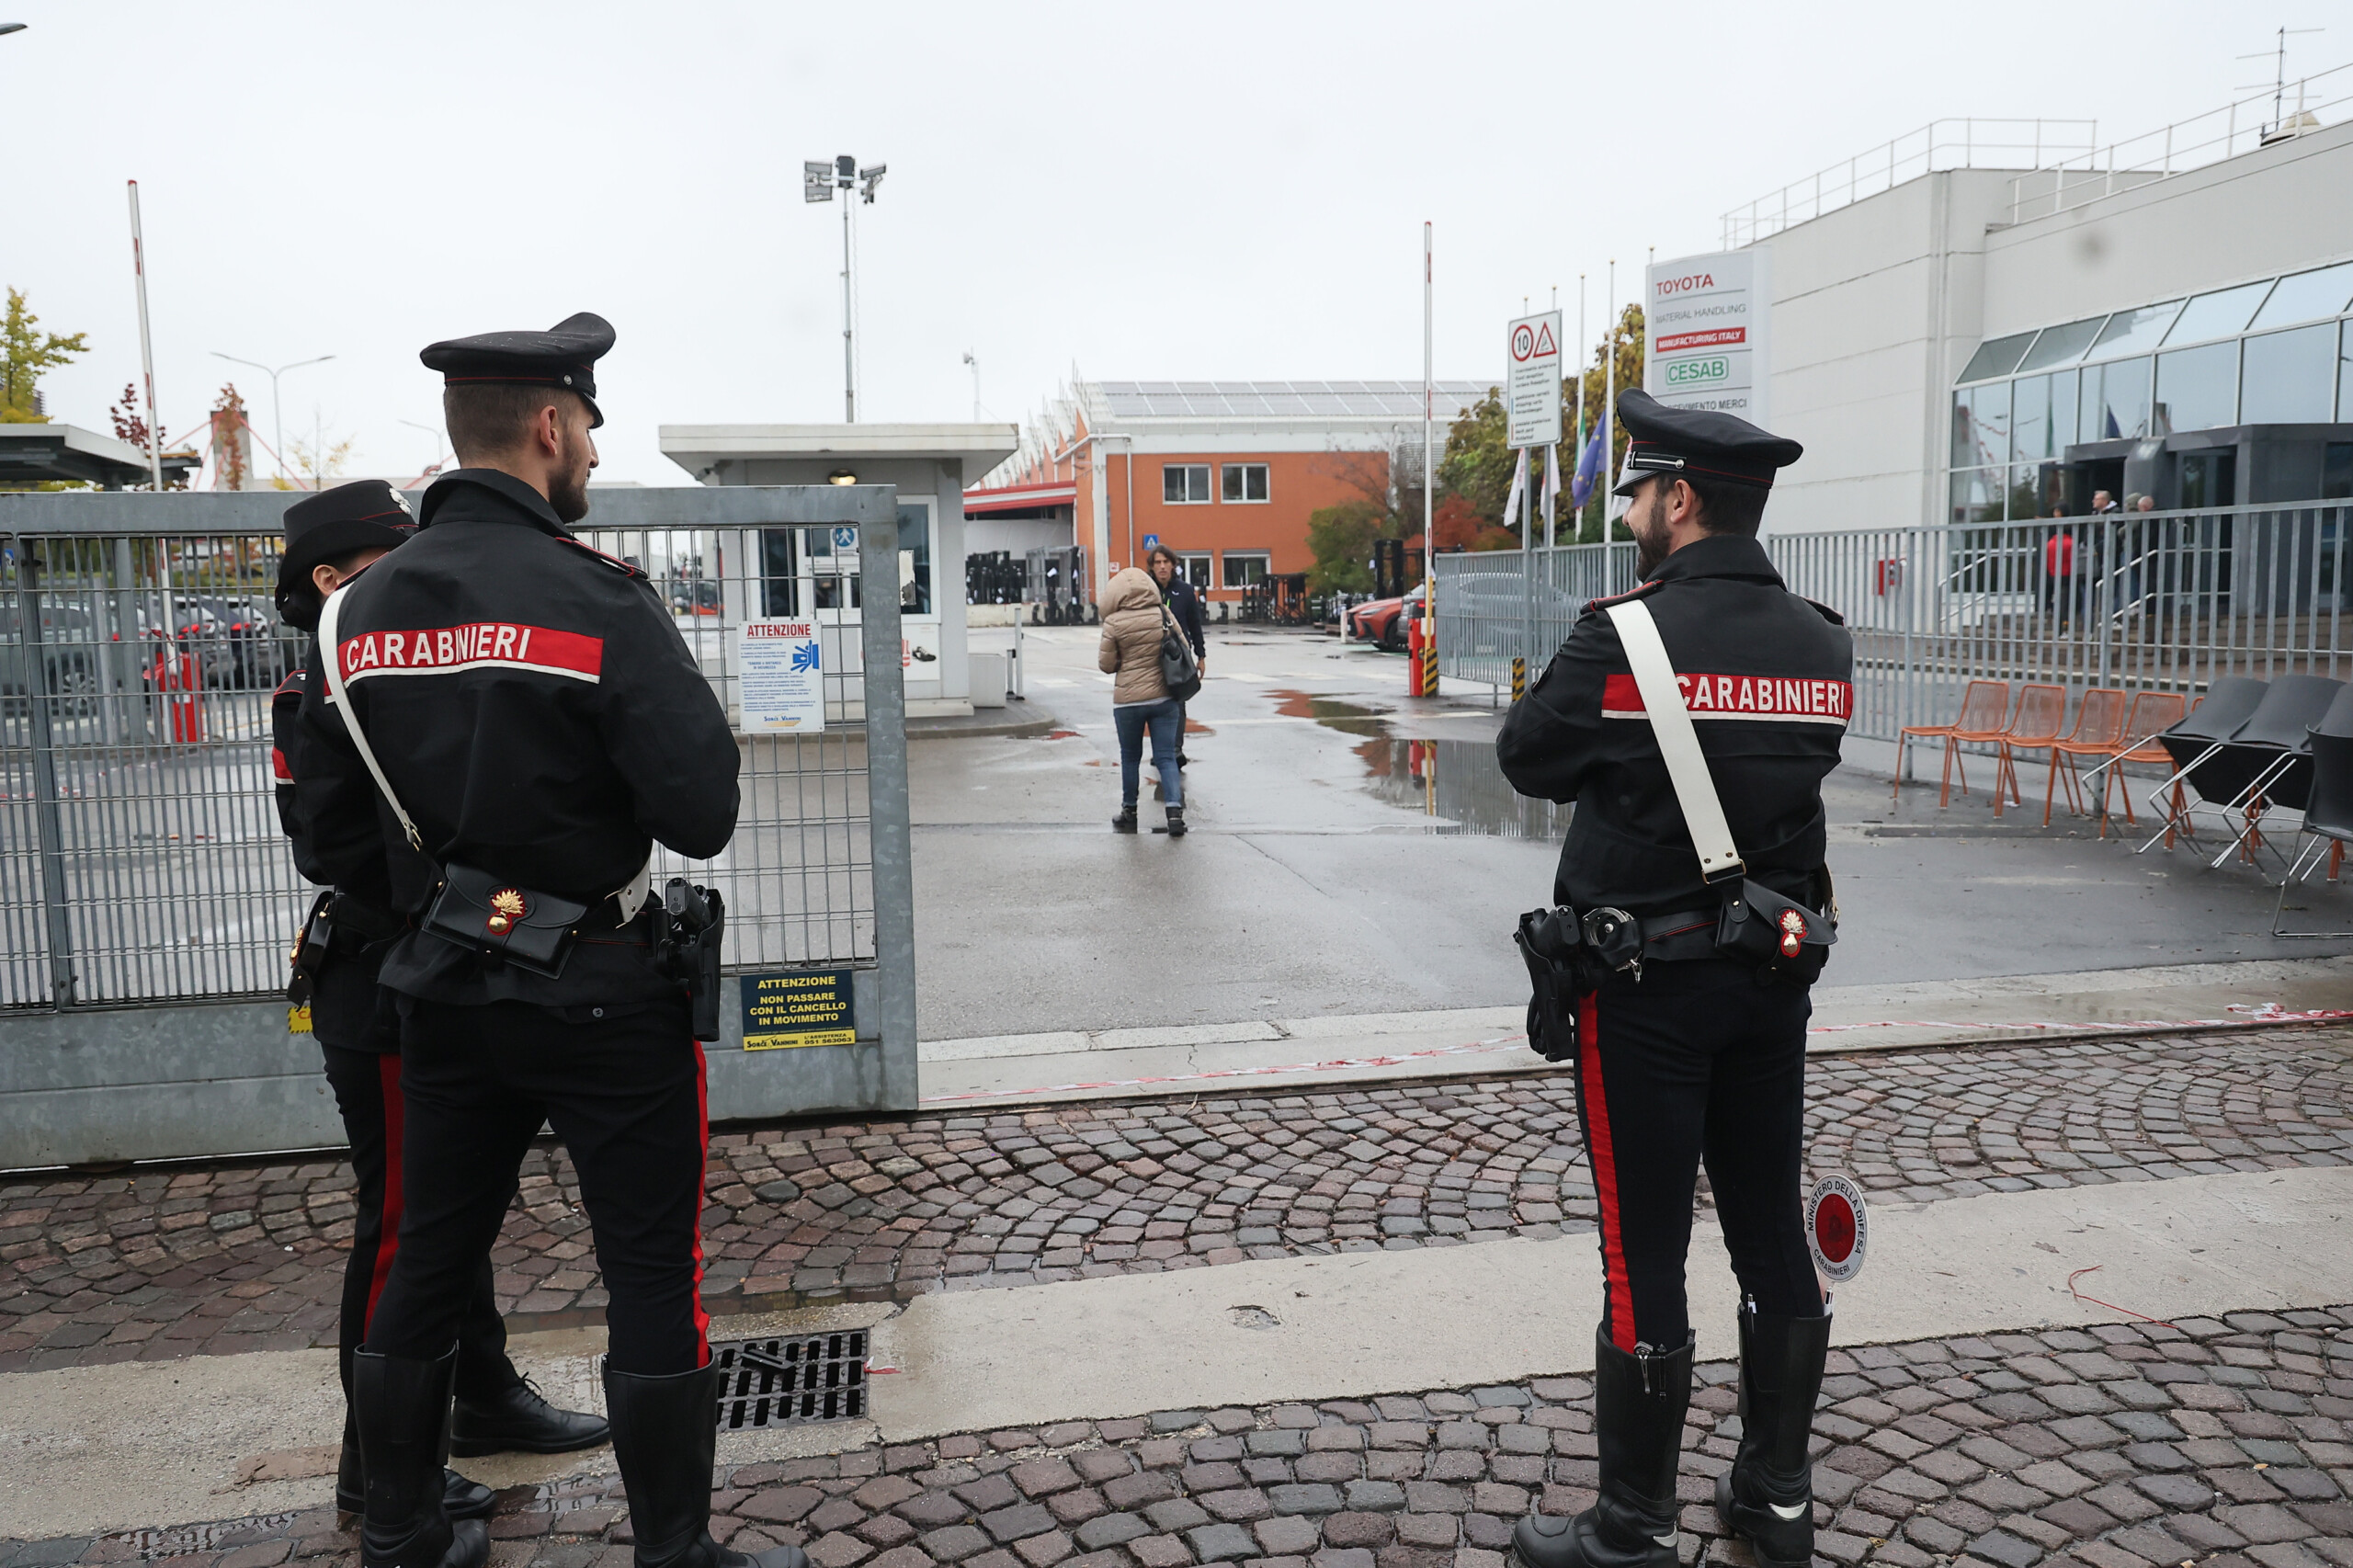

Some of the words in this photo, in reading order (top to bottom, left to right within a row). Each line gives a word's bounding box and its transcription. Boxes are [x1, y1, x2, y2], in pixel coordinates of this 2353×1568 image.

[1656, 274, 1714, 295] TOYOTA
[1655, 311, 1692, 324] MATERIAL
[1694, 303, 1746, 318] HANDLING
[1518, 334, 1529, 352] 10
[1658, 333, 1717, 348] MANUFACTURING
[1718, 331, 1742, 341] ITALY
[1668, 360, 1724, 381] CESAB
[1719, 398, 1746, 409] MERCI
[747, 624, 811, 637] ATTENZIONE
[347, 625, 531, 673] CARABINIERI
[1676, 675, 1846, 715] CARABINIERI
[757, 976, 836, 989] ATTENZIONE
[760, 995, 784, 1004] NON
[787, 992, 835, 1003] PASSARE
[750, 1007, 774, 1016] CON
[776, 1006, 787, 1014] IL
[790, 1002, 847, 1013] CANCELLO
[758, 1017, 770, 1026] IN
[773, 1013, 839, 1025] MOVIMENTO
[1808, 1181, 1833, 1231] MINISTERO
[1836, 1181, 1859, 1208] DELLA
[1855, 1210, 1865, 1254] DIFESA
[1814, 1248, 1850, 1276] CARABINIERI
